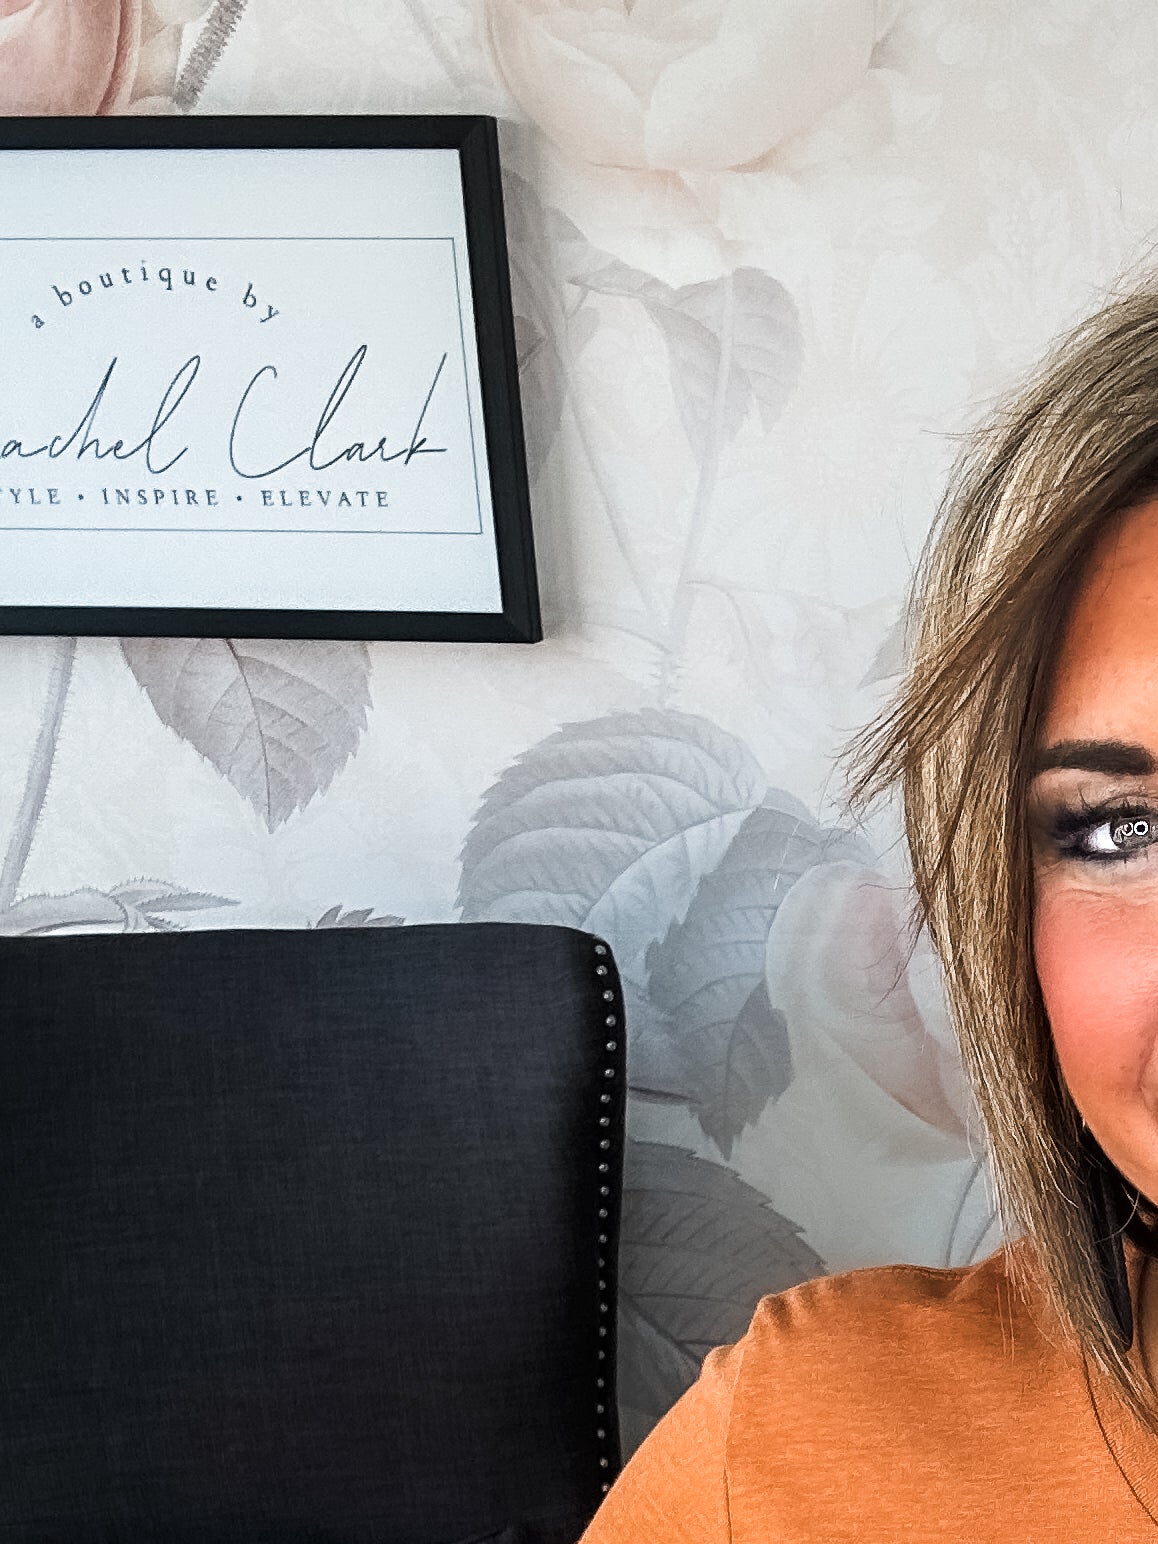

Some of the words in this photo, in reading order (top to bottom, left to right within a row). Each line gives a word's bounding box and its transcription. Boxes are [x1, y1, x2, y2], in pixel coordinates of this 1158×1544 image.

[31, 314, 45, 329] a
[51, 260, 218, 306] boutique
[242, 283, 280, 324] by
[0, 355, 200, 474] achel
[229, 344, 449, 479] Clark
[0, 487, 61, 505] YLE
[102, 487, 219, 506] INSPIRE
[260, 489, 390, 508] ELEVATE
